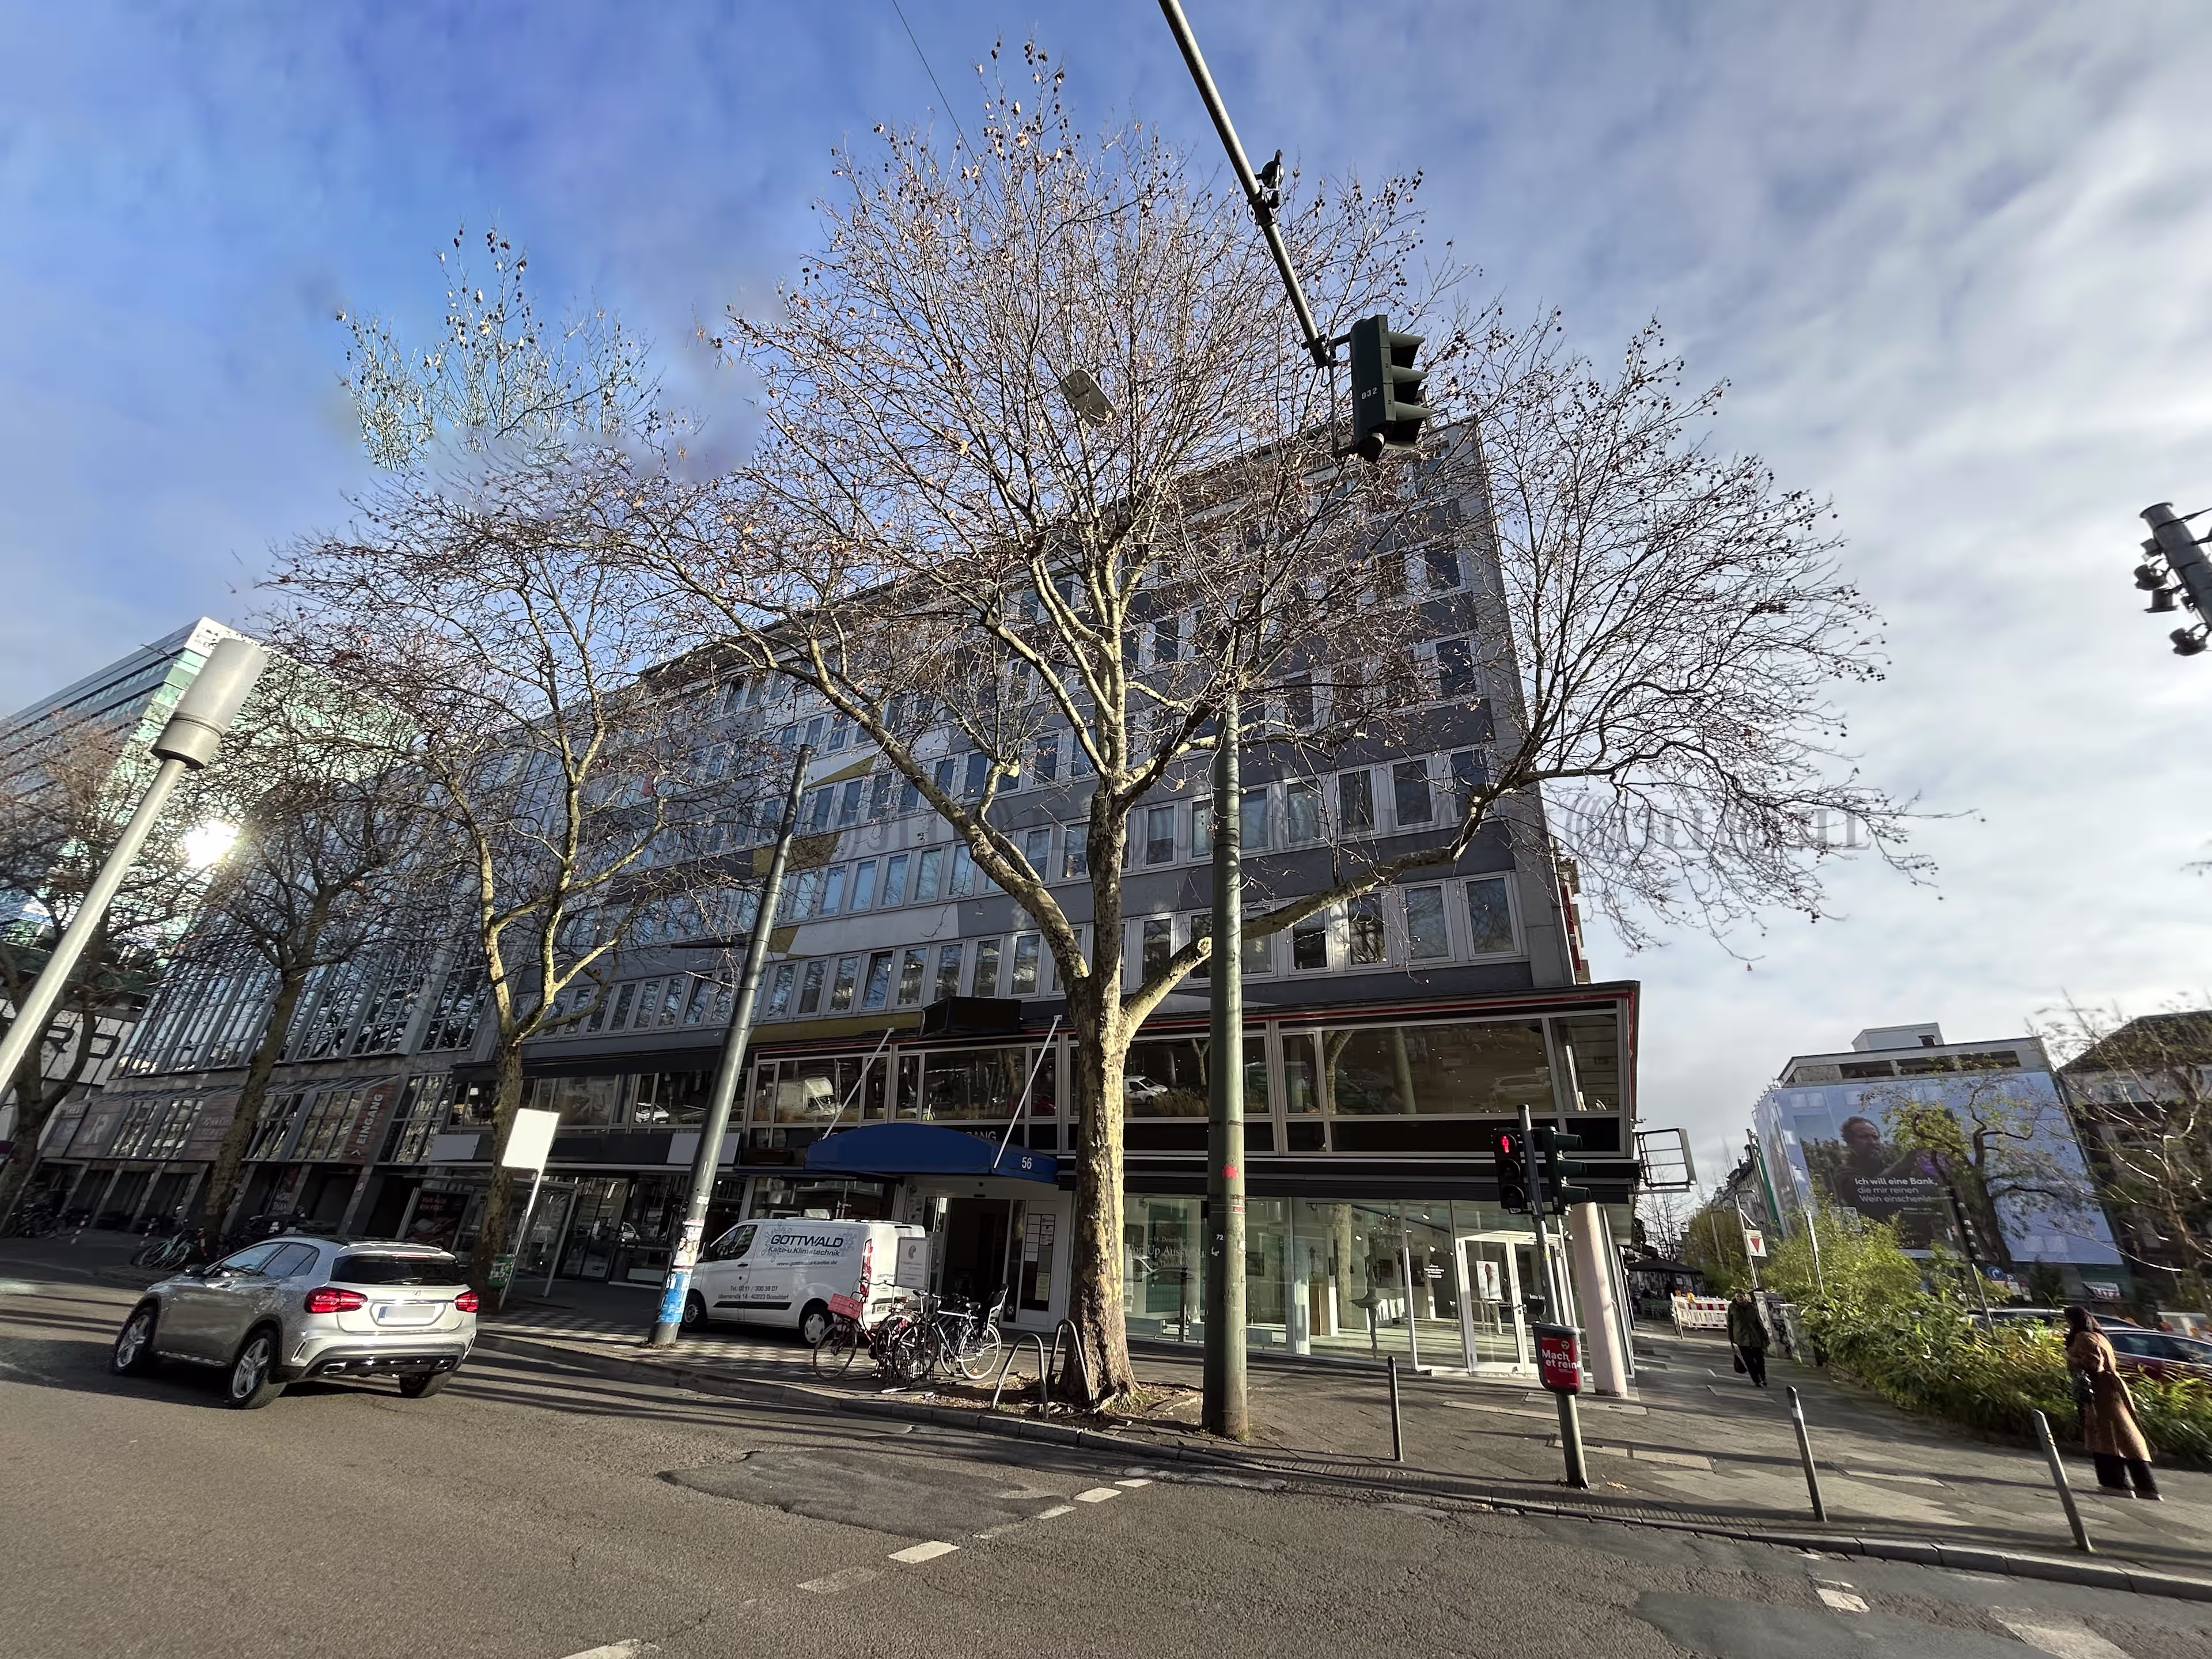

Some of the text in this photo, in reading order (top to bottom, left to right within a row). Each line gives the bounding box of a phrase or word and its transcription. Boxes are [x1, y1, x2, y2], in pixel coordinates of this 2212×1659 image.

[1361, 387, 1377, 399] 032
[356, 1093, 383, 1144] EINGANG
[1021, 1156, 1032, 1170] 56
[1910, 1177, 1938, 1185] Bank,
[770, 1234, 844, 1248] GOTTWALD
[1147, 1244, 1161, 1258] Up
[1545, 1359, 1556, 1367] et
